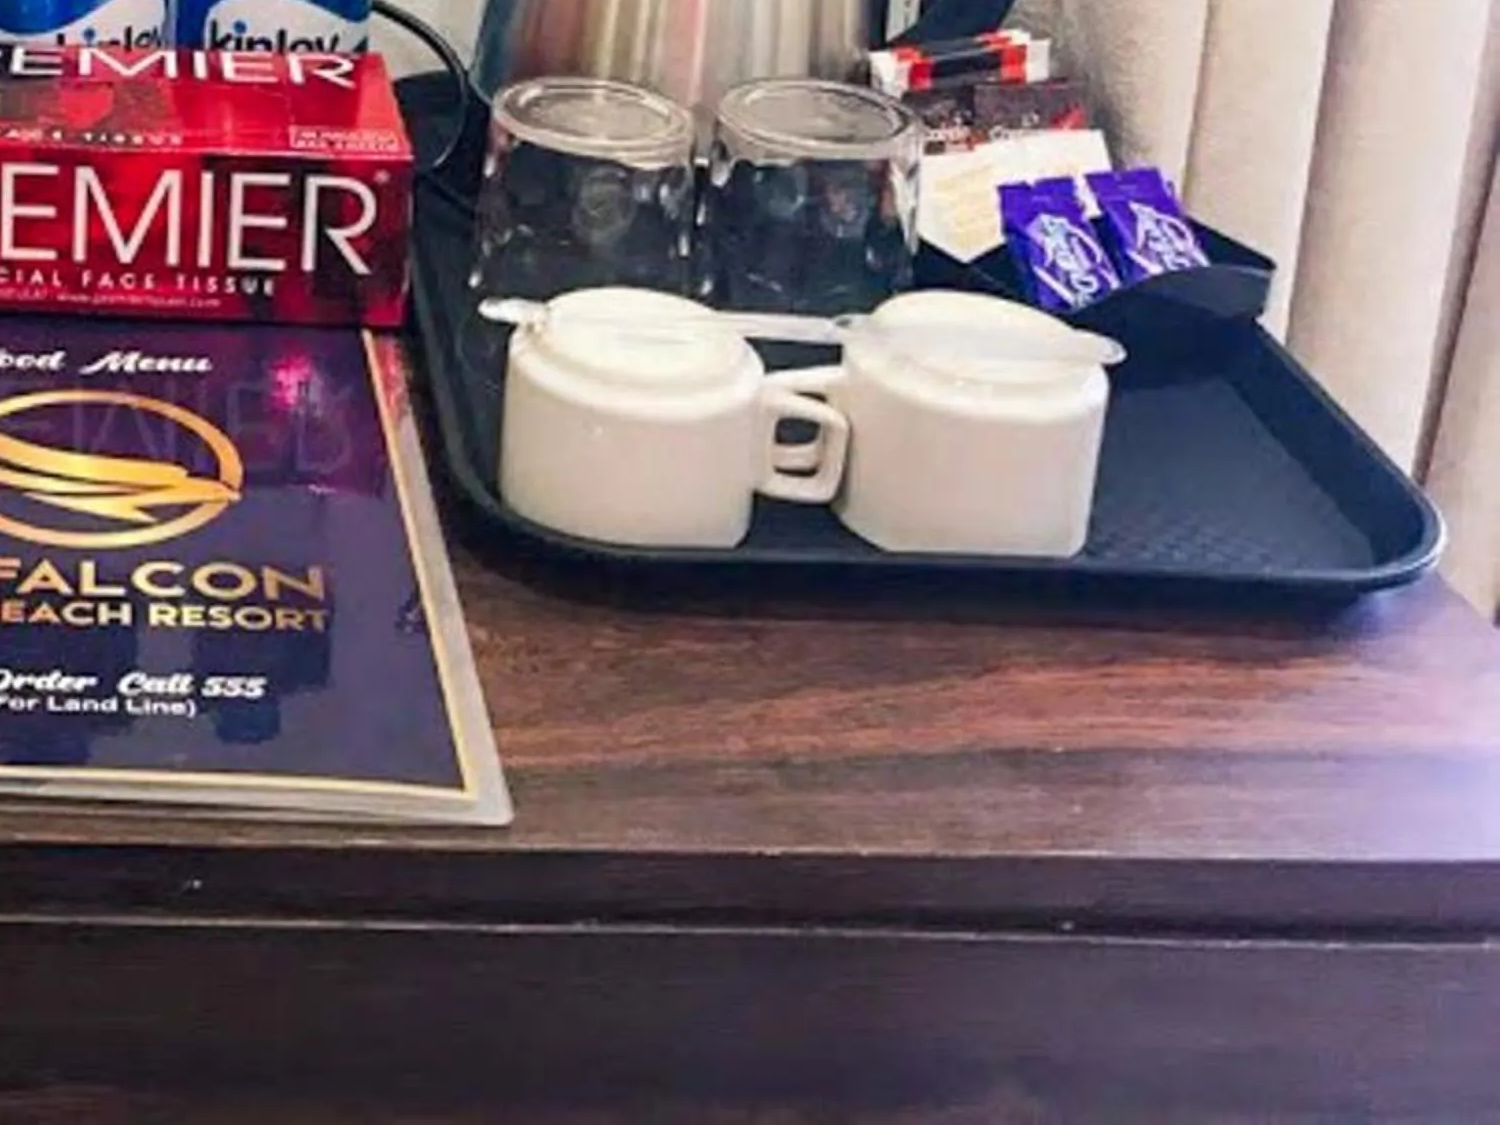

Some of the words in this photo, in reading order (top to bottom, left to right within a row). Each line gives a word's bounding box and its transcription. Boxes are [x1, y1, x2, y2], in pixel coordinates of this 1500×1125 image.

[80, 269, 155, 290] FACE
[176, 273, 276, 297] TISSUE
[78, 350, 214, 374] Menu
[148, 602, 330, 633] RESORT
[116, 671, 193, 696] Call
[47, 696, 118, 713] Land
[125, 698, 196, 718] Line)
